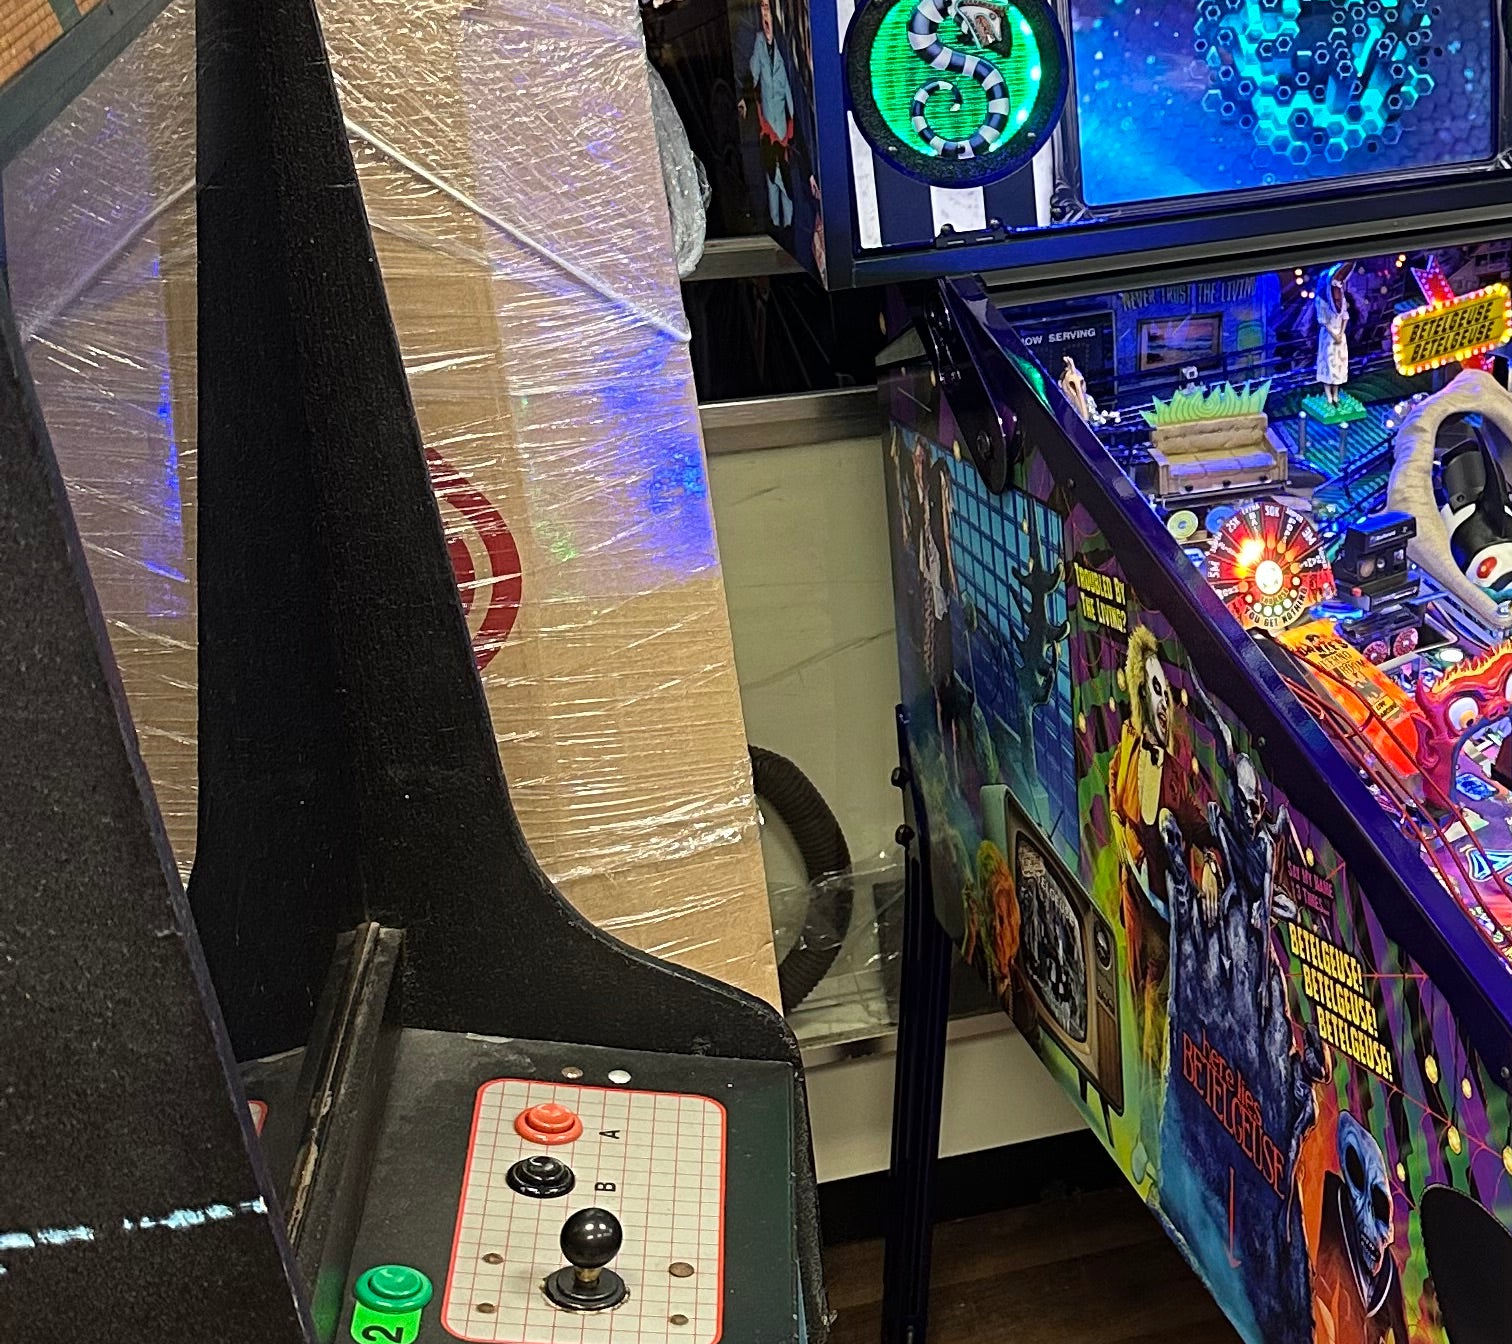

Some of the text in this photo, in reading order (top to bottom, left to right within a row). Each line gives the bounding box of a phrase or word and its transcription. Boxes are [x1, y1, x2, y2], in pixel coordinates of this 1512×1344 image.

[1198, 281, 1216, 304] THE
[1048, 327, 1097, 344] SERVING
[1410, 301, 1494, 344] BETELGEUSE
[1411, 321, 1495, 363] BETELGEUSE
[1263, 616, 1279, 628] GET
[1287, 860, 1301, 879] SAY
[1288, 921, 1364, 994] BETELGEUSE!
[1302, 963, 1379, 1038] BETELGEUSE!
[1316, 1005, 1394, 1082] BETELGEUSE!
[1202, 1027, 1263, 1127] here lies
[1182, 1031, 1285, 1200] BETELGEUSE
[602, 1128, 621, 1141] A
[595, 1180, 617, 1192] B
[367, 1323, 405, 1344] 2
